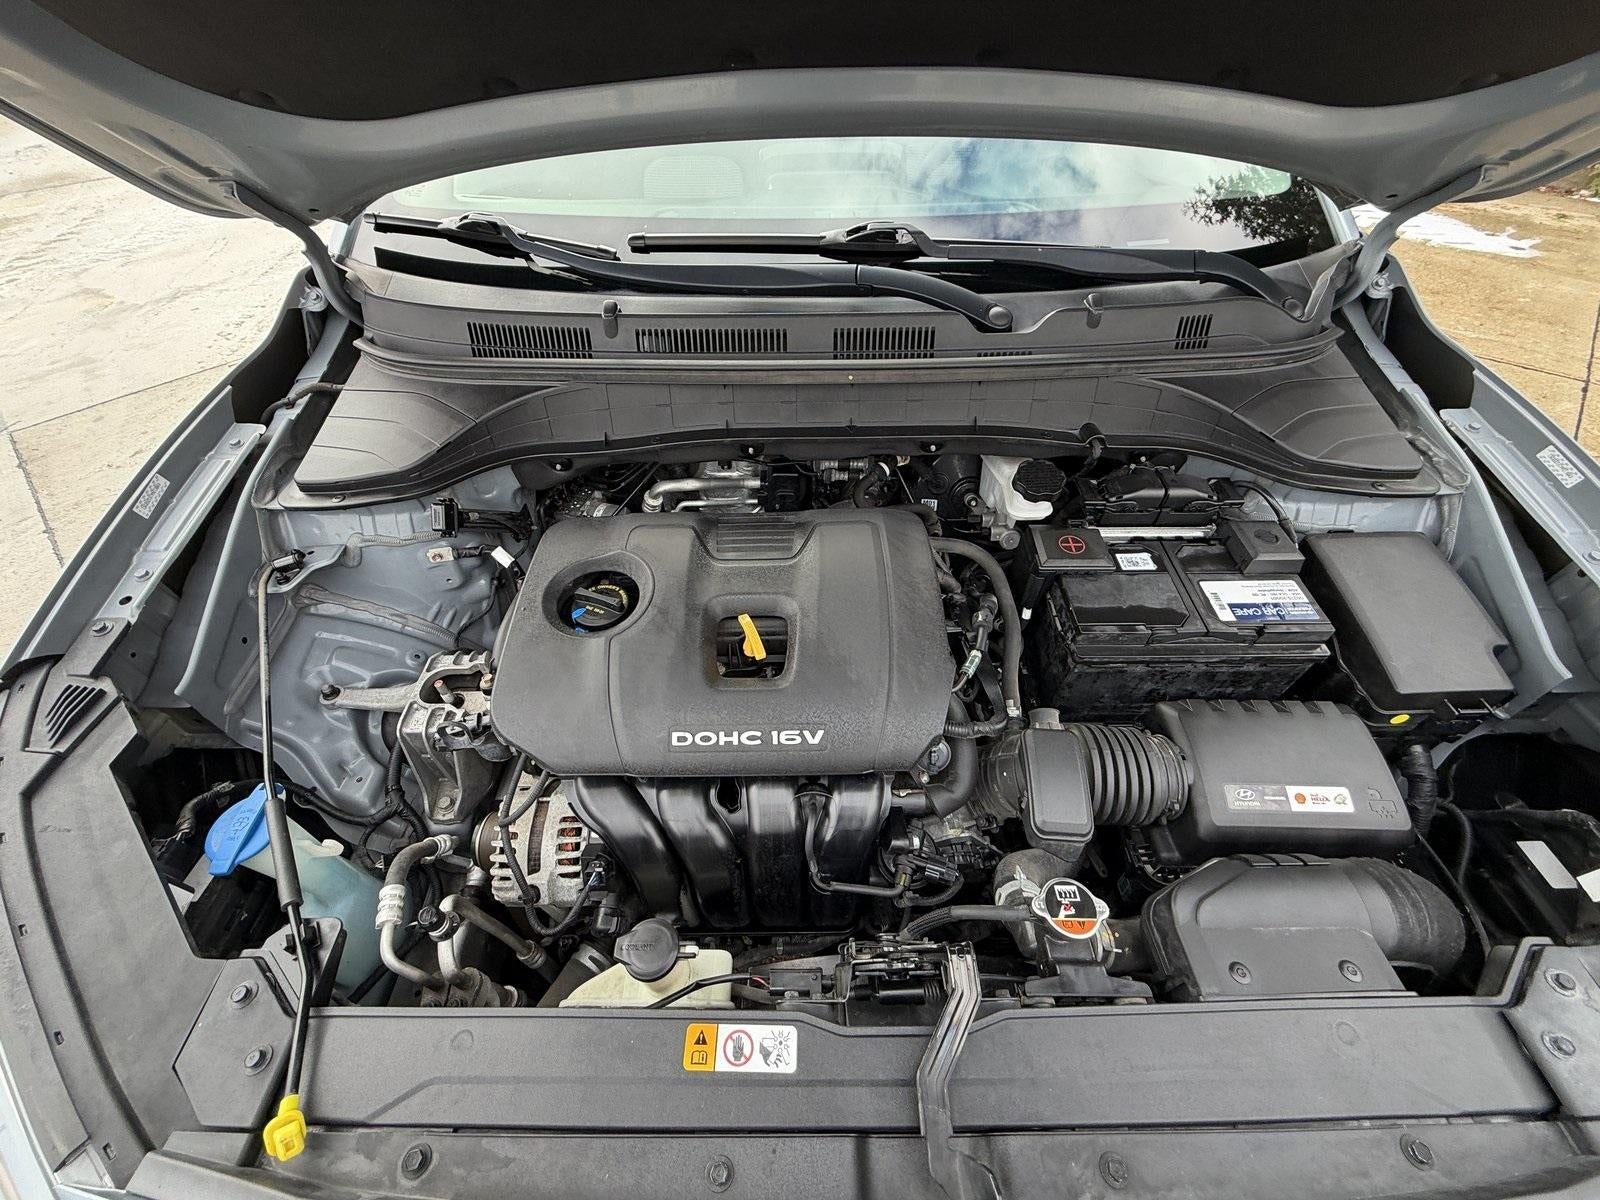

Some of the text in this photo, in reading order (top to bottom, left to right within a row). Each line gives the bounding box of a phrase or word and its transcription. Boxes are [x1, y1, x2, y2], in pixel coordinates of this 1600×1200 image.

[1231, 607, 1262, 617] CARE
[1262, 605, 1285, 617] CAR
[671, 729, 825, 746] DOHC 16V
